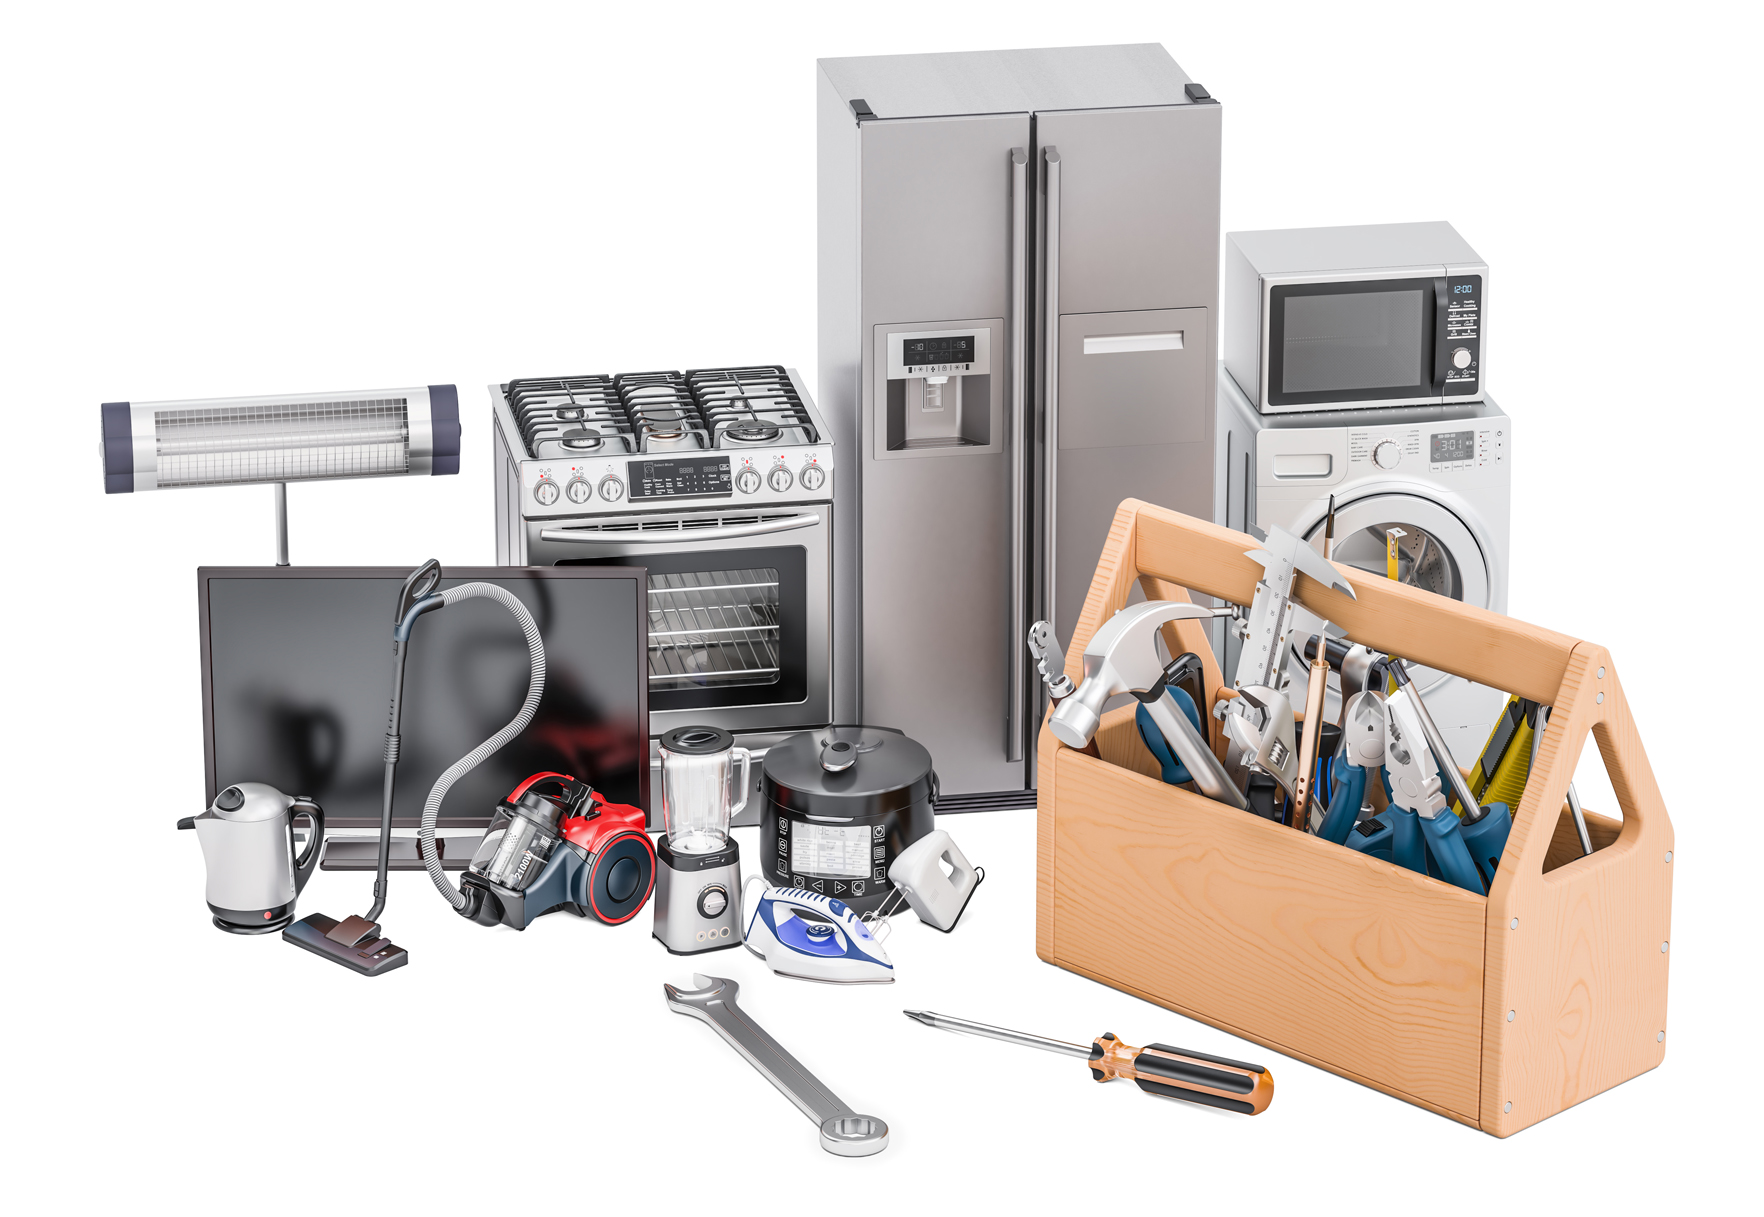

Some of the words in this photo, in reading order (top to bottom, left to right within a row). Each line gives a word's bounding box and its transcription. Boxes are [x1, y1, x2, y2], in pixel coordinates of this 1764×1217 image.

[1454, 285, 1472, 293] 12:00
[1442, 440, 1461, 450] 3:01
[514, 850, 534, 879] 2100W
